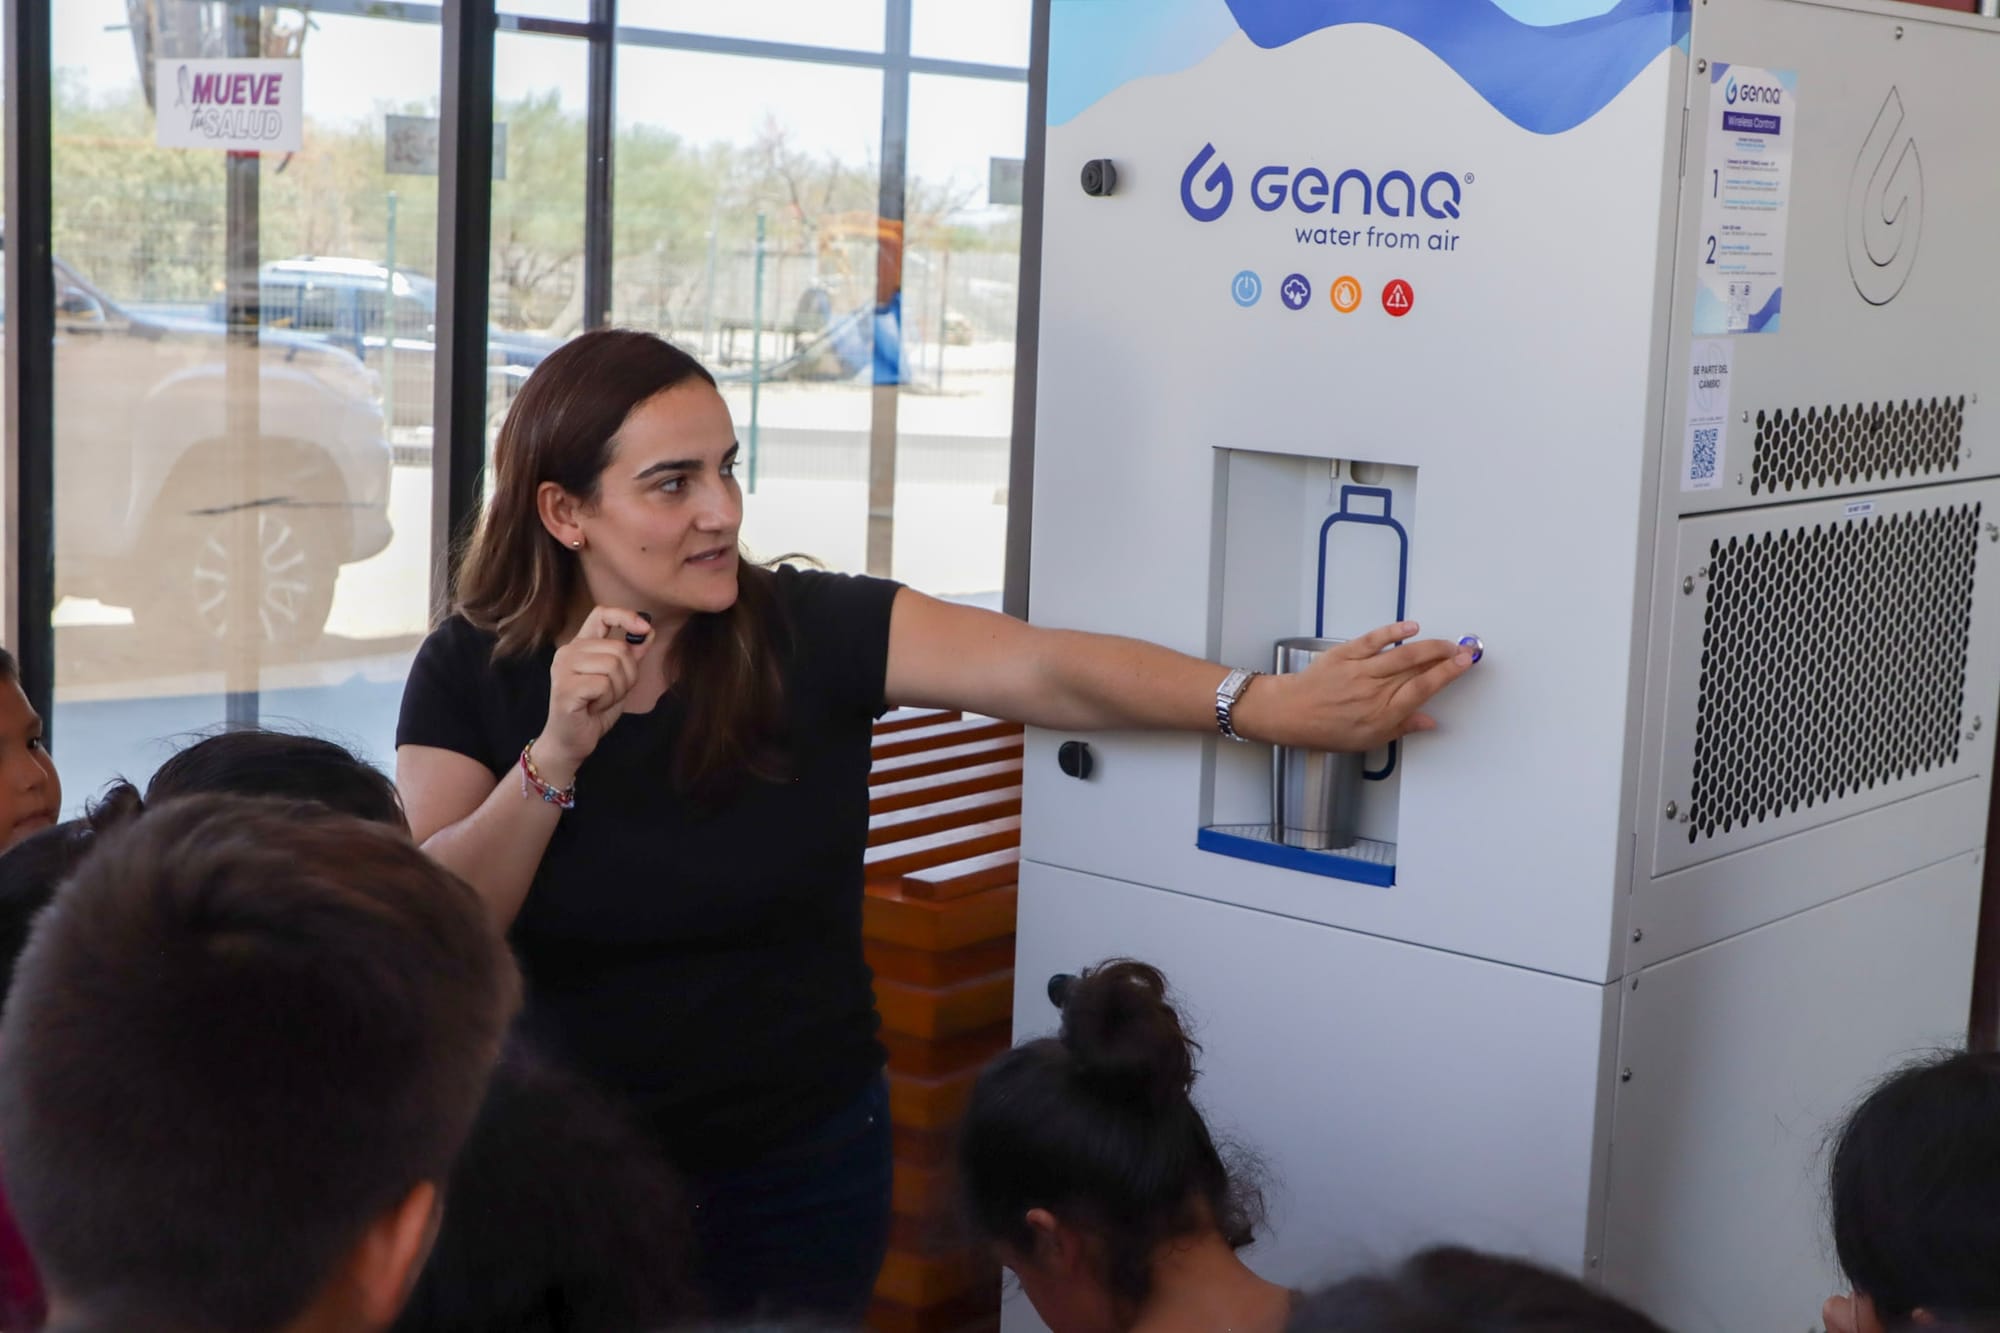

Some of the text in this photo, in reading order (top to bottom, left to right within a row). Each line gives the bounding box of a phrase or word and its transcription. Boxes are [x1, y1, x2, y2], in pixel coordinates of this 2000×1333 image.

[192, 73, 282, 105] MUEVE
[203, 108, 282, 140] SALUD
[1727, 115, 1777, 130] Wireless Control
[1713, 169, 1719, 199] 1
[1295, 226, 1460, 251] water from air
[1705, 235, 1717, 264] 2
[1701, 364, 1718, 375] PARTE
[1699, 379, 1721, 389] CAMBIO
